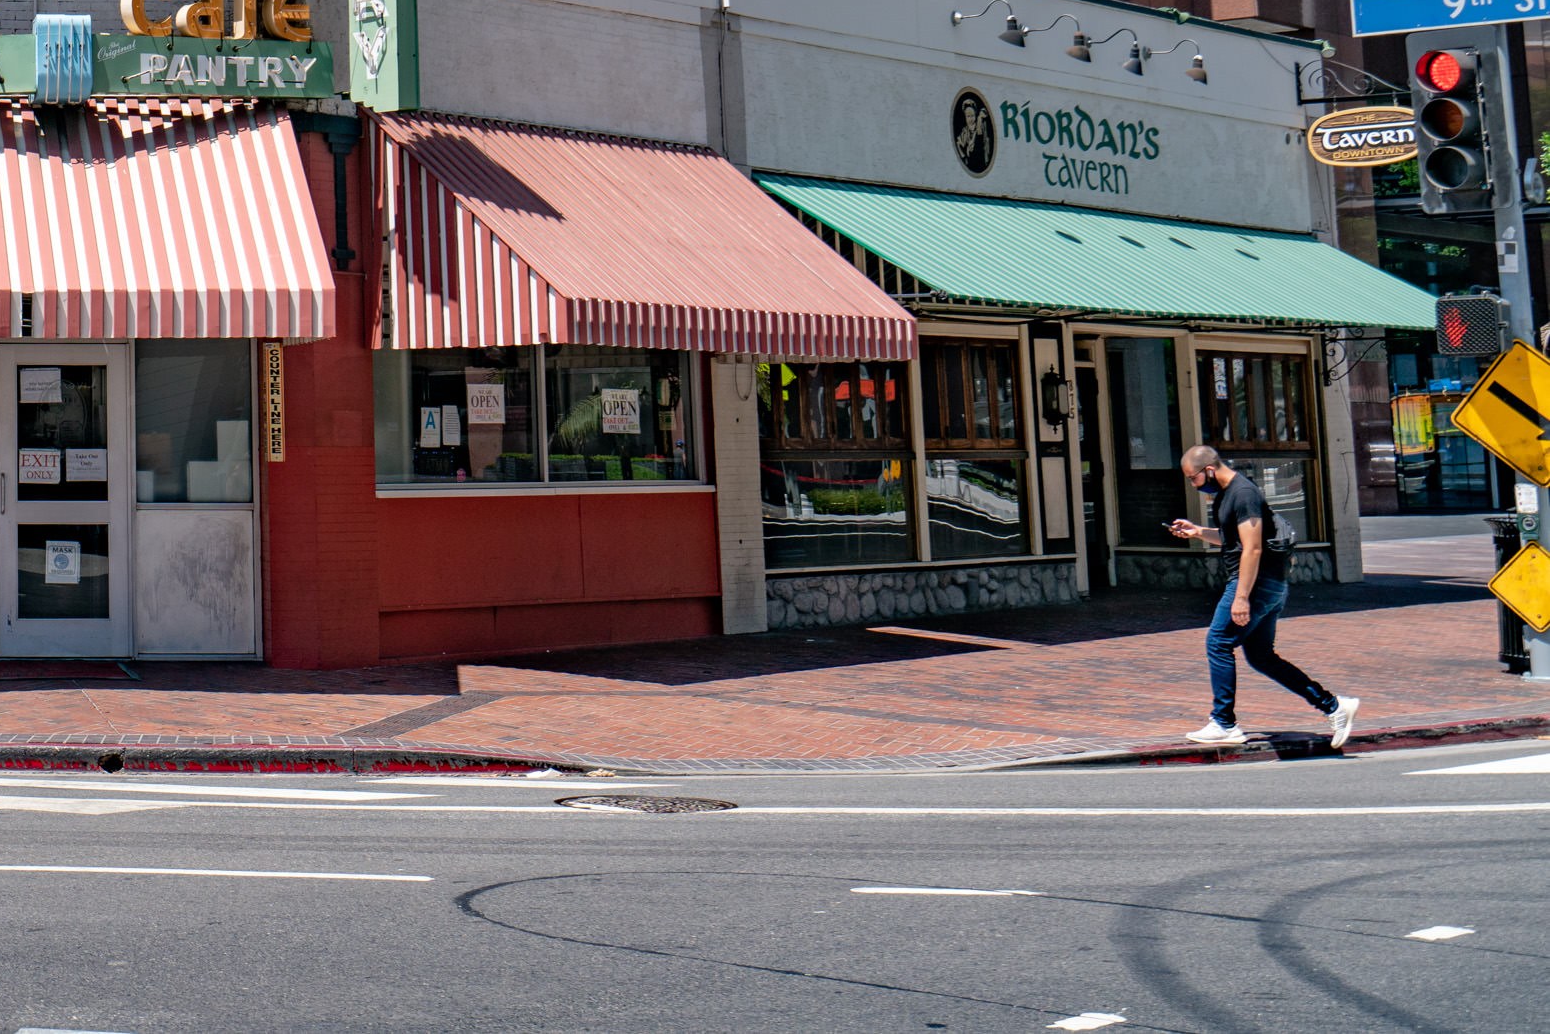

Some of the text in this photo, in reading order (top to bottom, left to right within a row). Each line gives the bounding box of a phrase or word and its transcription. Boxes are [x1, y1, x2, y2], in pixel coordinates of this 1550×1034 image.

[97, 40, 317, 88] Original PANTRY
[1354, 114, 1376, 122] THE
[1333, 148, 1405, 159] DOWNTOWN
[269, 349, 282, 454] COUNTER LINE HERE
[471, 396, 499, 408] OPEN
[604, 400, 637, 416] OPEN
[425, 410, 436, 429] A
[21, 454, 59, 467] EXIT
[26, 471, 53, 479] ONLY
